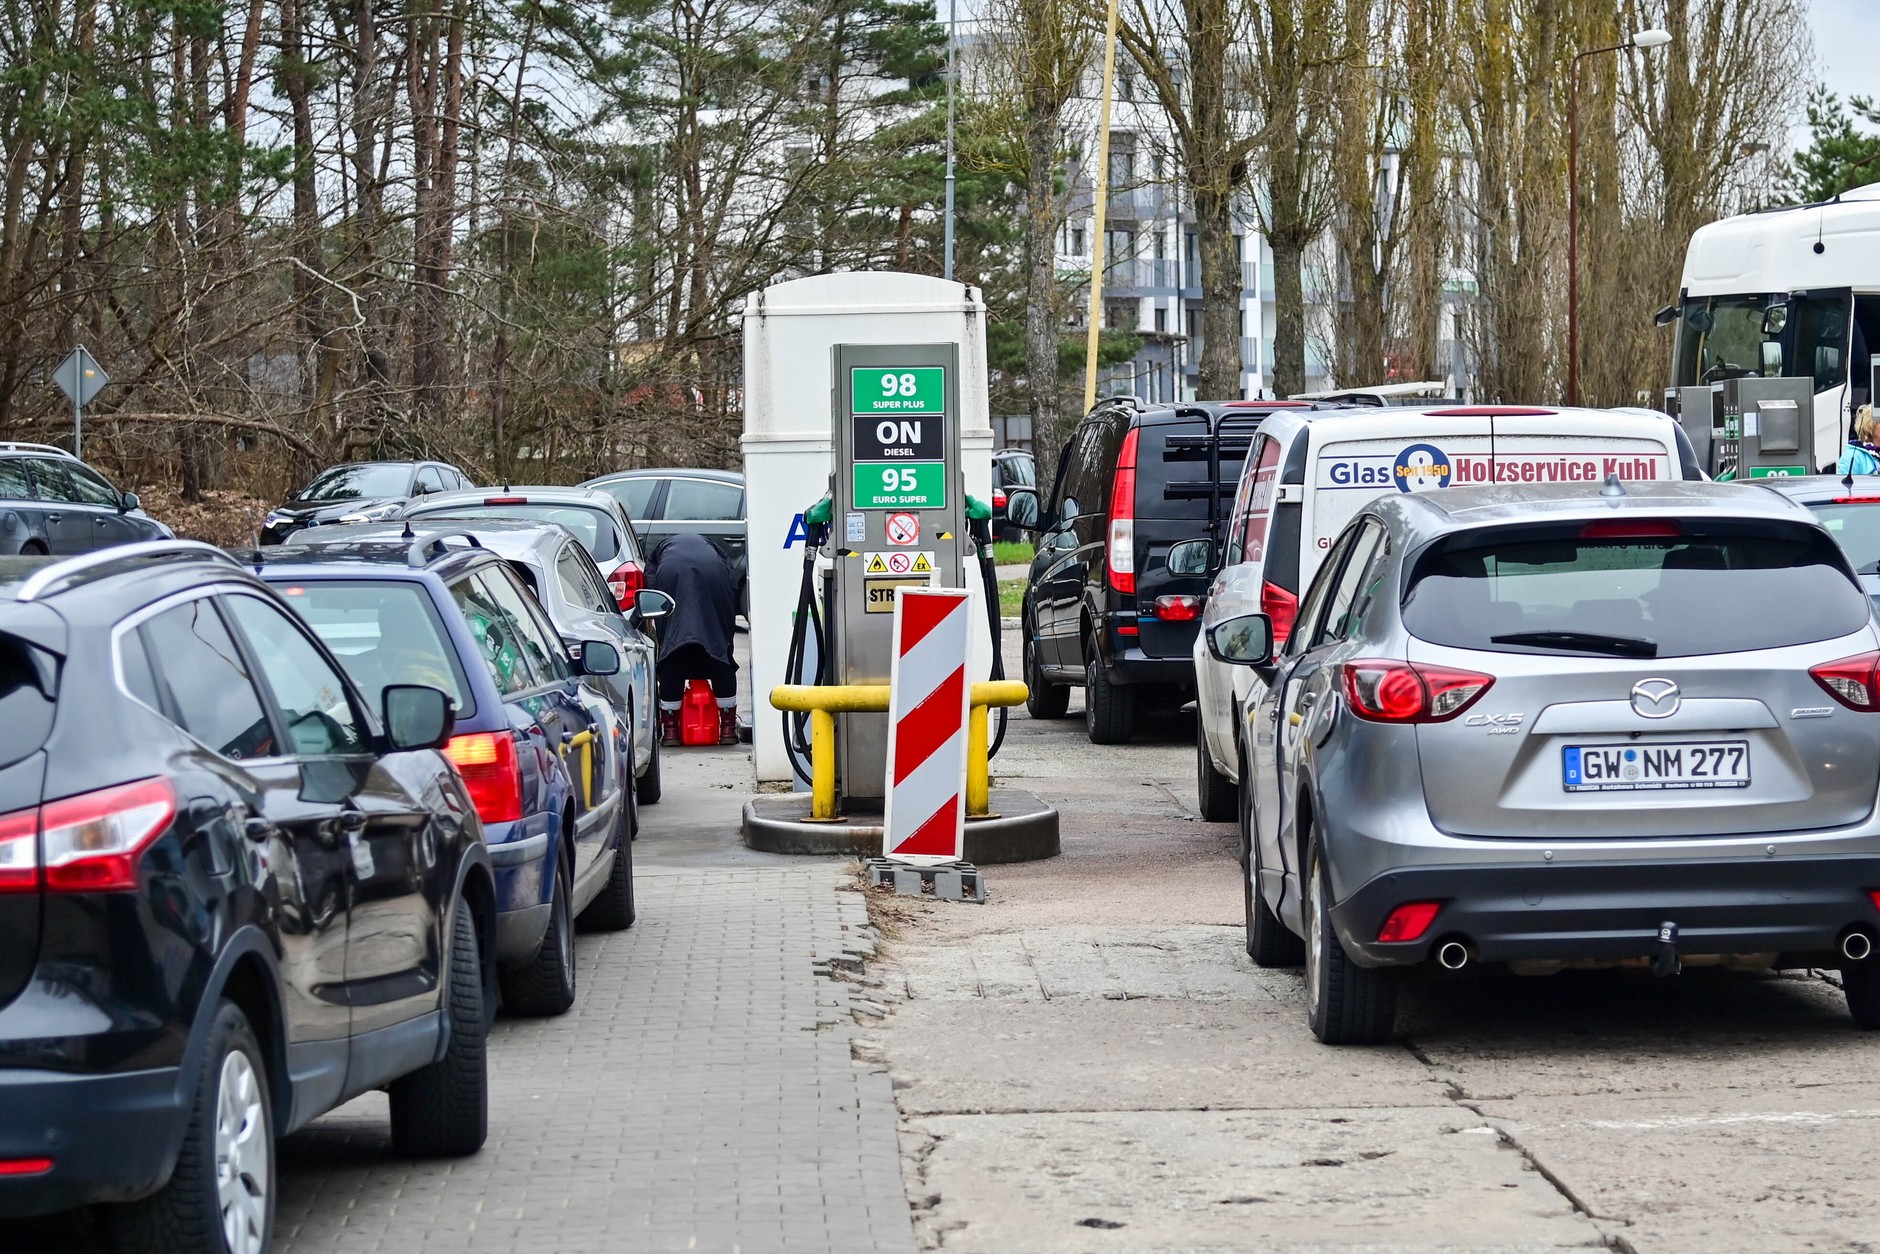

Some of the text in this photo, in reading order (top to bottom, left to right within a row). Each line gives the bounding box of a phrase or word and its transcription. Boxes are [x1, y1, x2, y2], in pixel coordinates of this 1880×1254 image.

[881, 373, 917, 397] 98
[872, 400, 925, 409] SUPER PLUS
[876, 421, 922, 445] ON
[884, 448, 915, 456] DIESEL
[1329, 462, 1390, 484] Glas
[1456, 458, 1597, 482] Holzservice
[1602, 458, 1656, 481] Kuhl
[1396, 464, 1449, 477] Seit 1950
[882, 468, 917, 492] 95
[872, 495, 928, 503] EURO SUPER
[870, 588, 895, 602] STR
[1464, 713, 1525, 727] CX-5
[1487, 727, 1520, 735] AWD
[1583, 747, 1744, 779] GW NM 277
[1569, 770, 1577, 779] D
[1635, 782, 1663, 790] Schmidt
